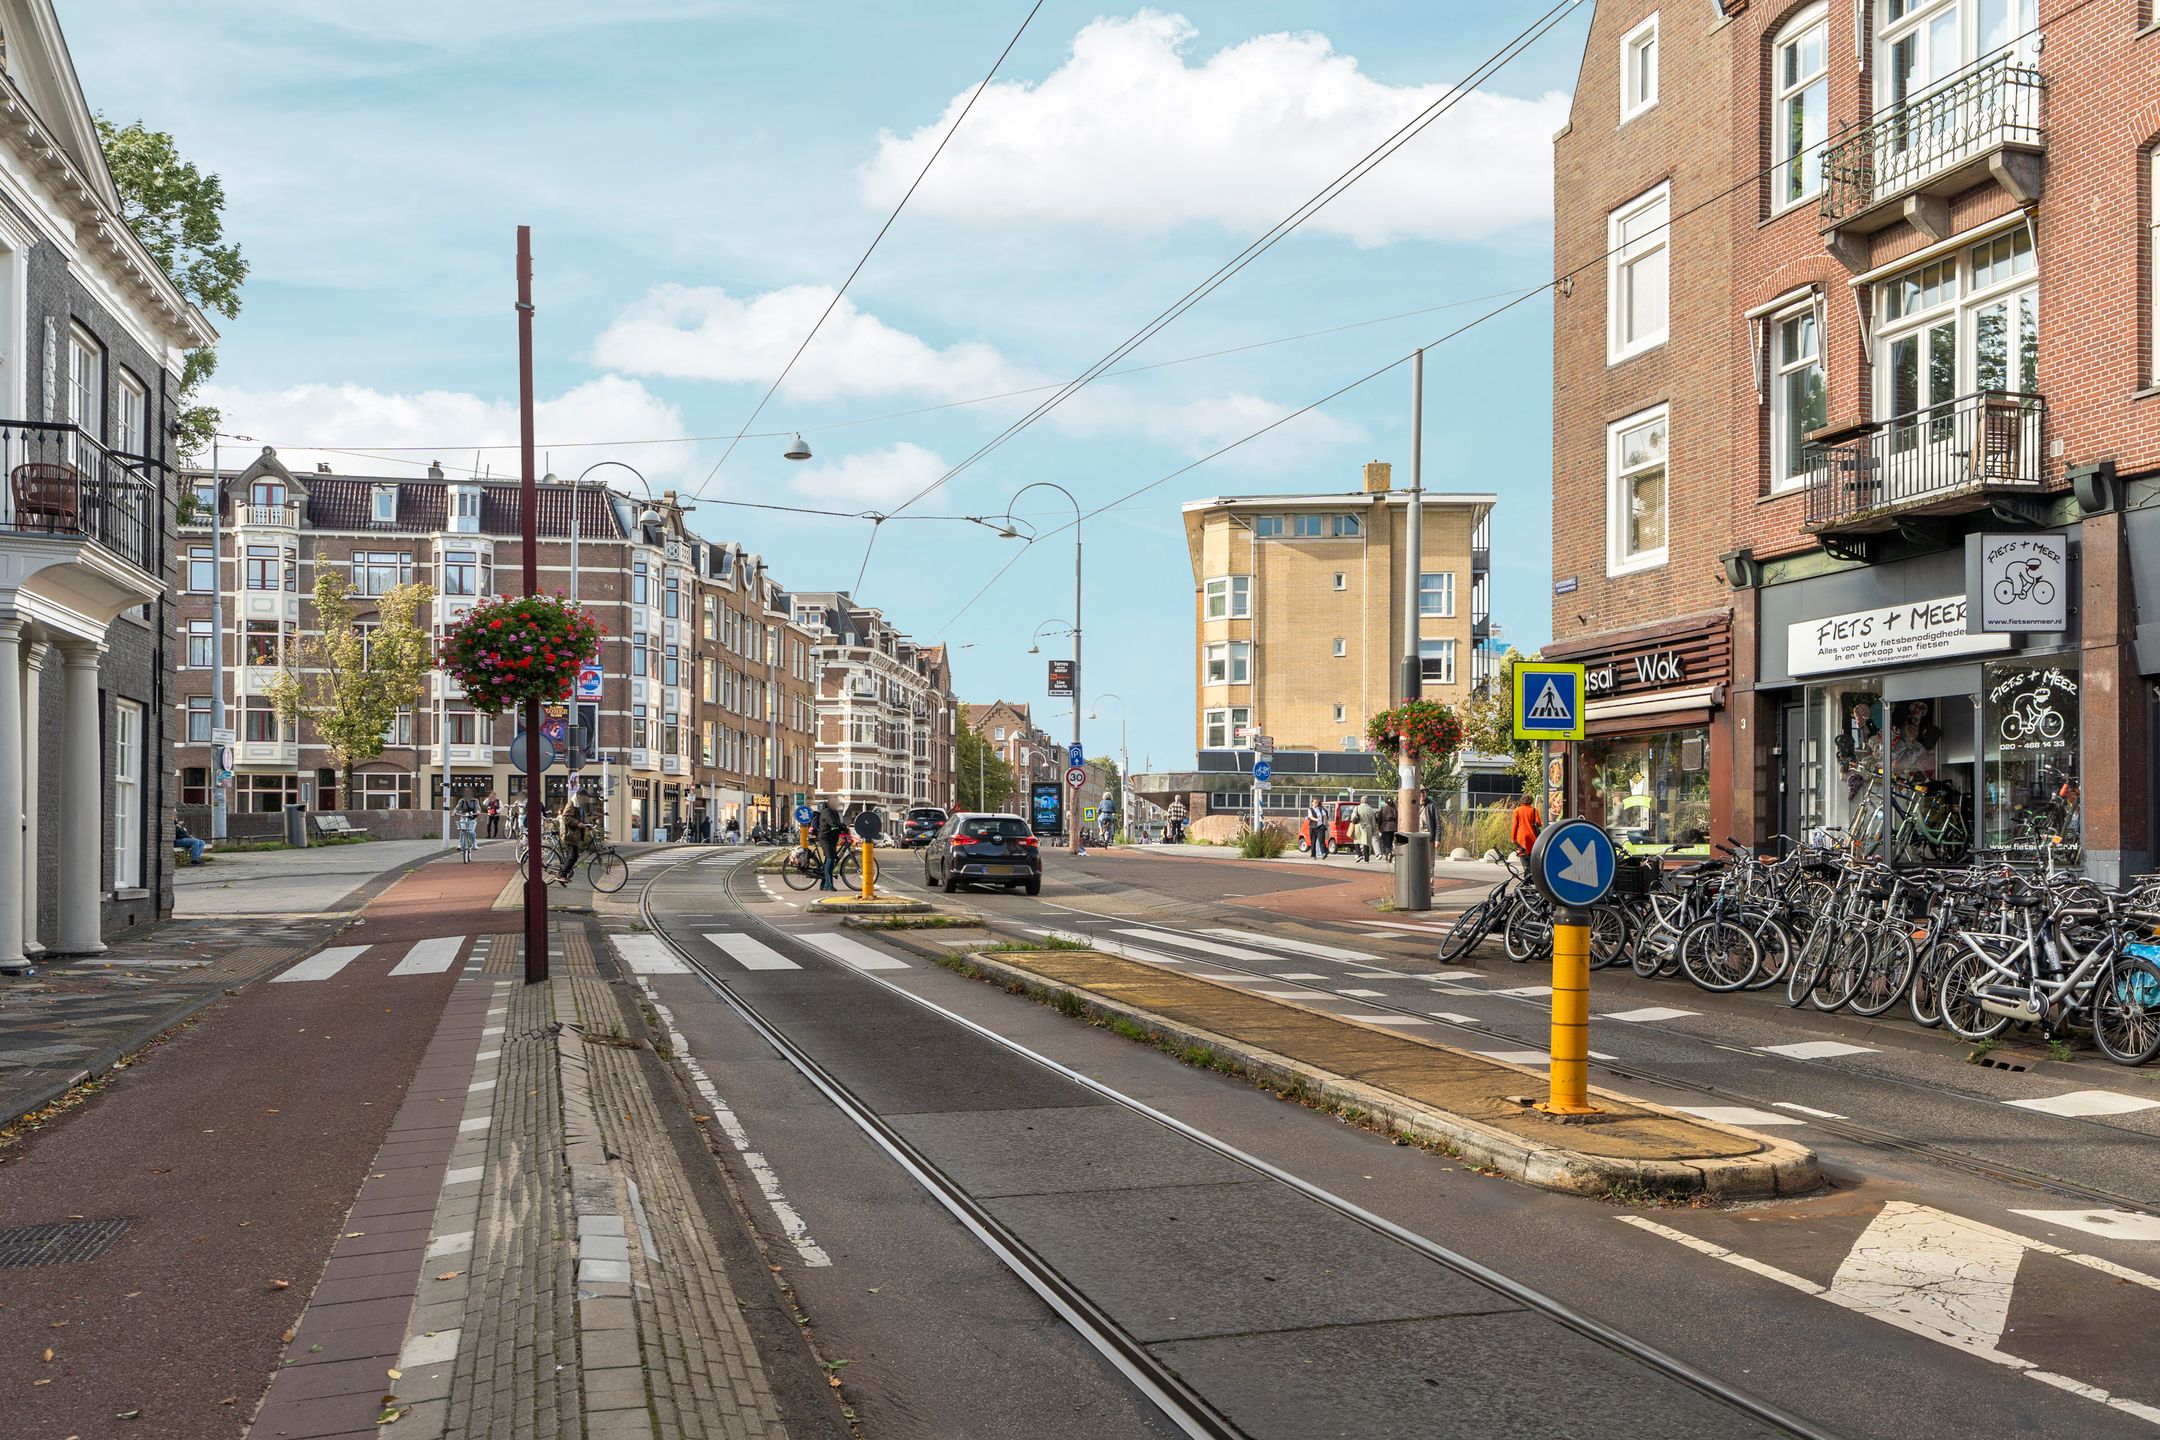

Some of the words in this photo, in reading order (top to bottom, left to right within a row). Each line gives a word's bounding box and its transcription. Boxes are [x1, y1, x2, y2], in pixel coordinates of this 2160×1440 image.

[1987, 541, 2017, 564] FIETS
[2020, 540, 2030, 549] +
[2032, 542, 2061, 564] MEER
[1816, 616, 1874, 646] FIETS
[1882, 611, 1902, 631] +
[1910, 600, 1967, 630] MEER
[1817, 645, 1838, 656] Alles
[1841, 643, 1860, 653] voor
[1863, 640, 1878, 649] Uw
[1834, 653, 1843, 661] In
[1845, 652, 1855, 660] en
[1858, 647, 1894, 659] verkoop
[1896, 644, 1913, 654] van
[1916, 640, 1949, 650] fietsen
[1862, 652, 1919, 665] www.fietsenmeer.nl
[1634, 651, 1680, 683] Wok
[1989, 673, 2024, 703] FIETS
[2027, 670, 2040, 681] +
[2042, 670, 2078, 696] MEER
[1740, 718, 1747, 730] 3
[1070, 773, 1083, 782] 30
